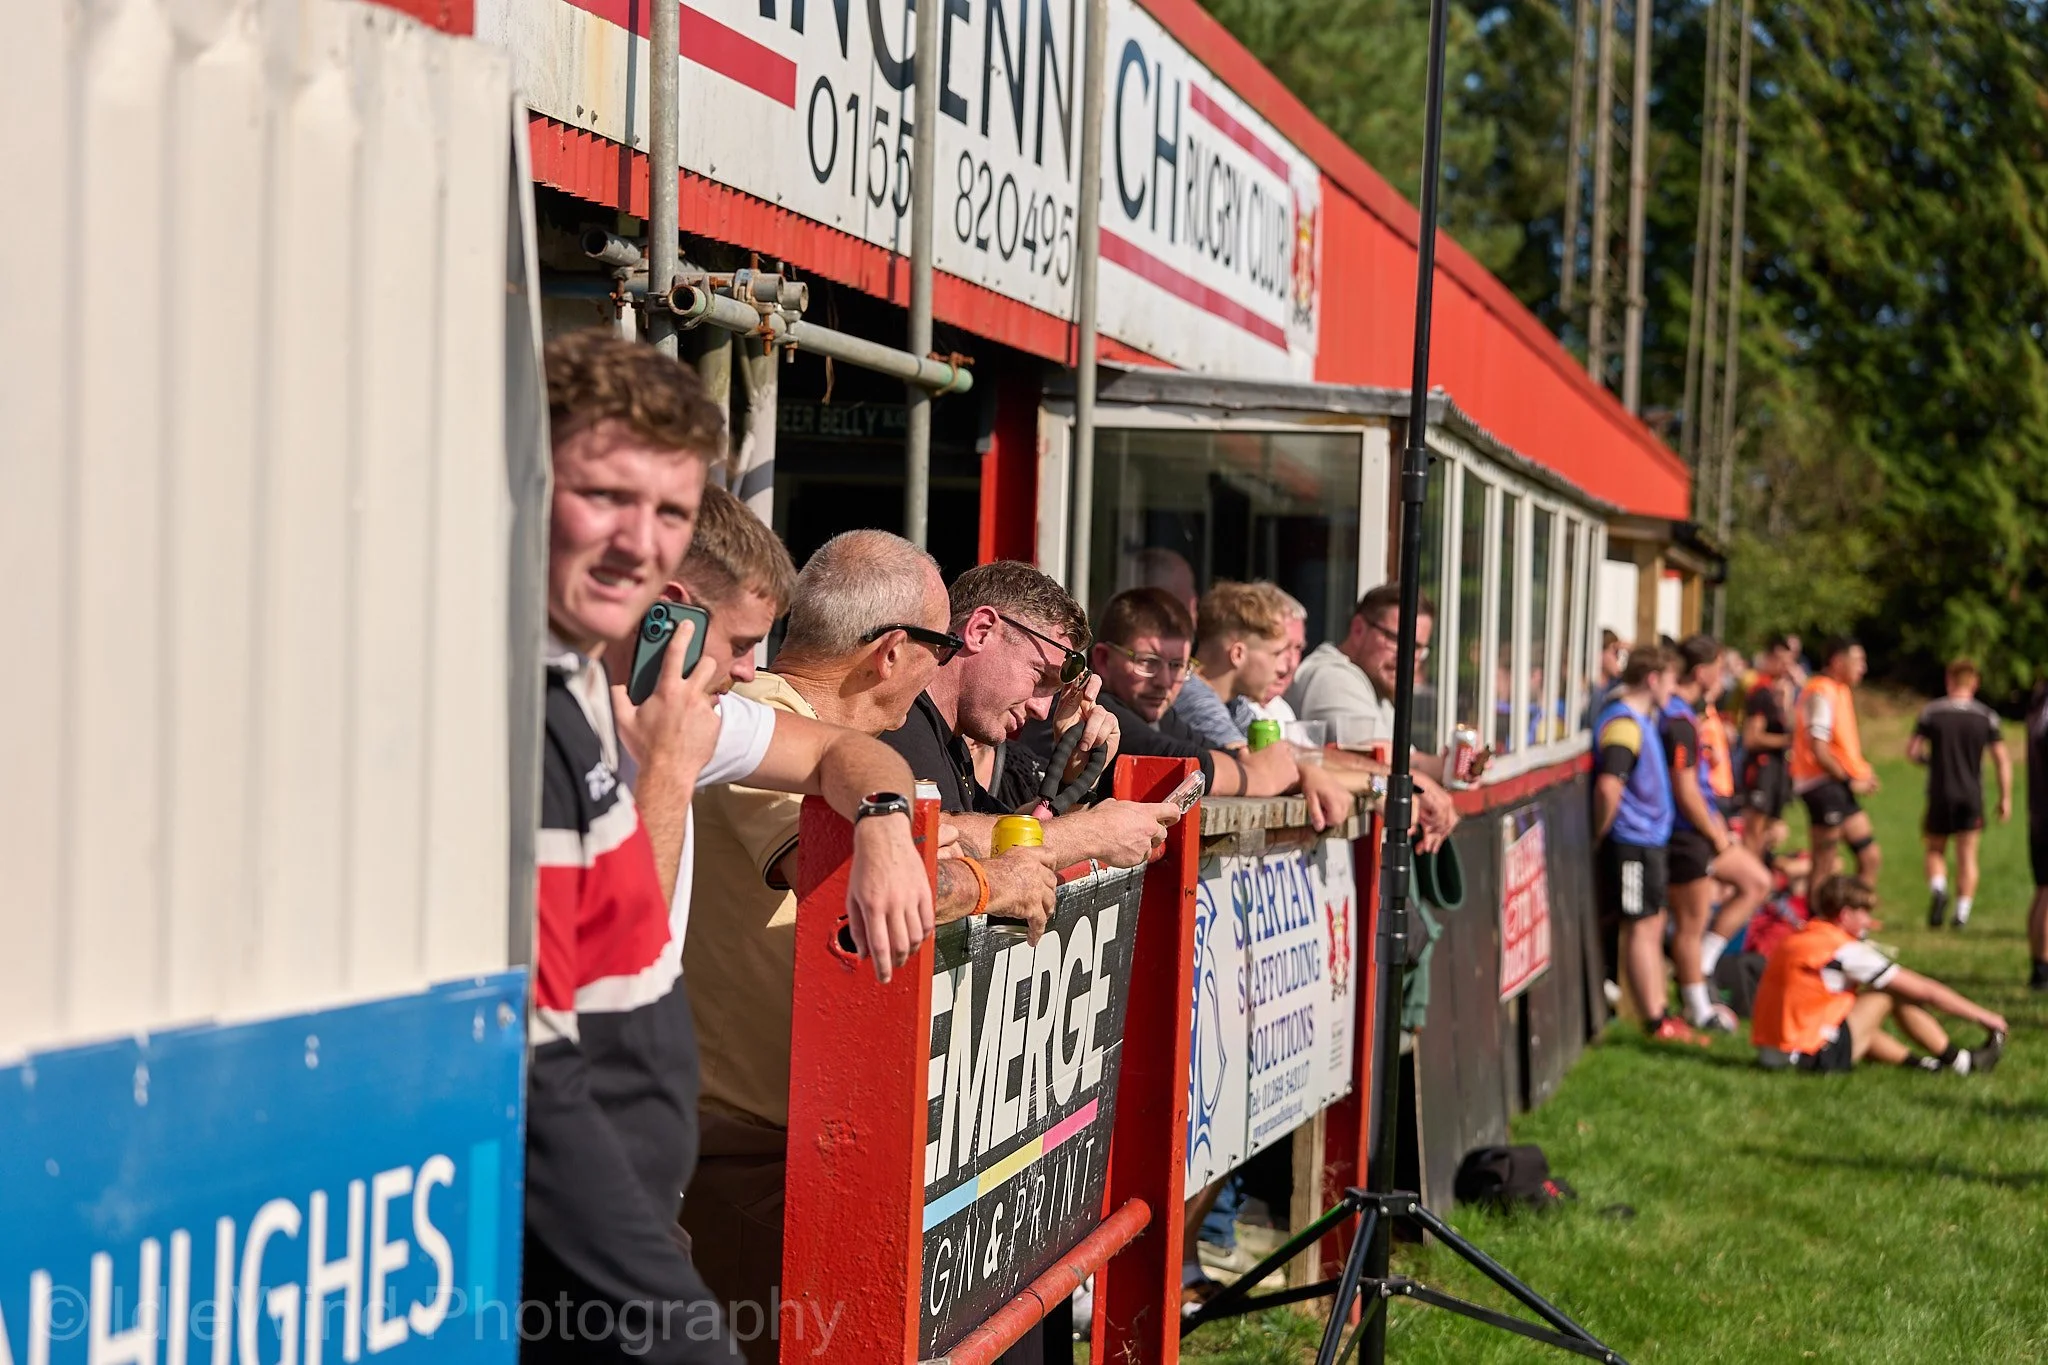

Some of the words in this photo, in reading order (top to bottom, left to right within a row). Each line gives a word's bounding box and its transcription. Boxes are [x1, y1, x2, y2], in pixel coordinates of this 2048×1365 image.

[807, 75, 914, 218] 0155
[955, 149, 1073, 287] 820495
[1184, 133, 1243, 274] RUGBY
[1248, 182, 1290, 298] CLUB
[781, 404, 815, 434] EER
[819, 405, 878, 436] BELLY
[1231, 855, 1317, 951] SPARTAN
[924, 903, 1119, 1187] EMERGE
[1237, 938, 1320, 1016] SCAFFOLDING
[1248, 1003, 1314, 1081] SOLUTIONS
[88, 1154, 456, 1365] HUGHES
[983, 1202, 1004, 1280] &
[1009, 1137, 1095, 1262] PRINT
